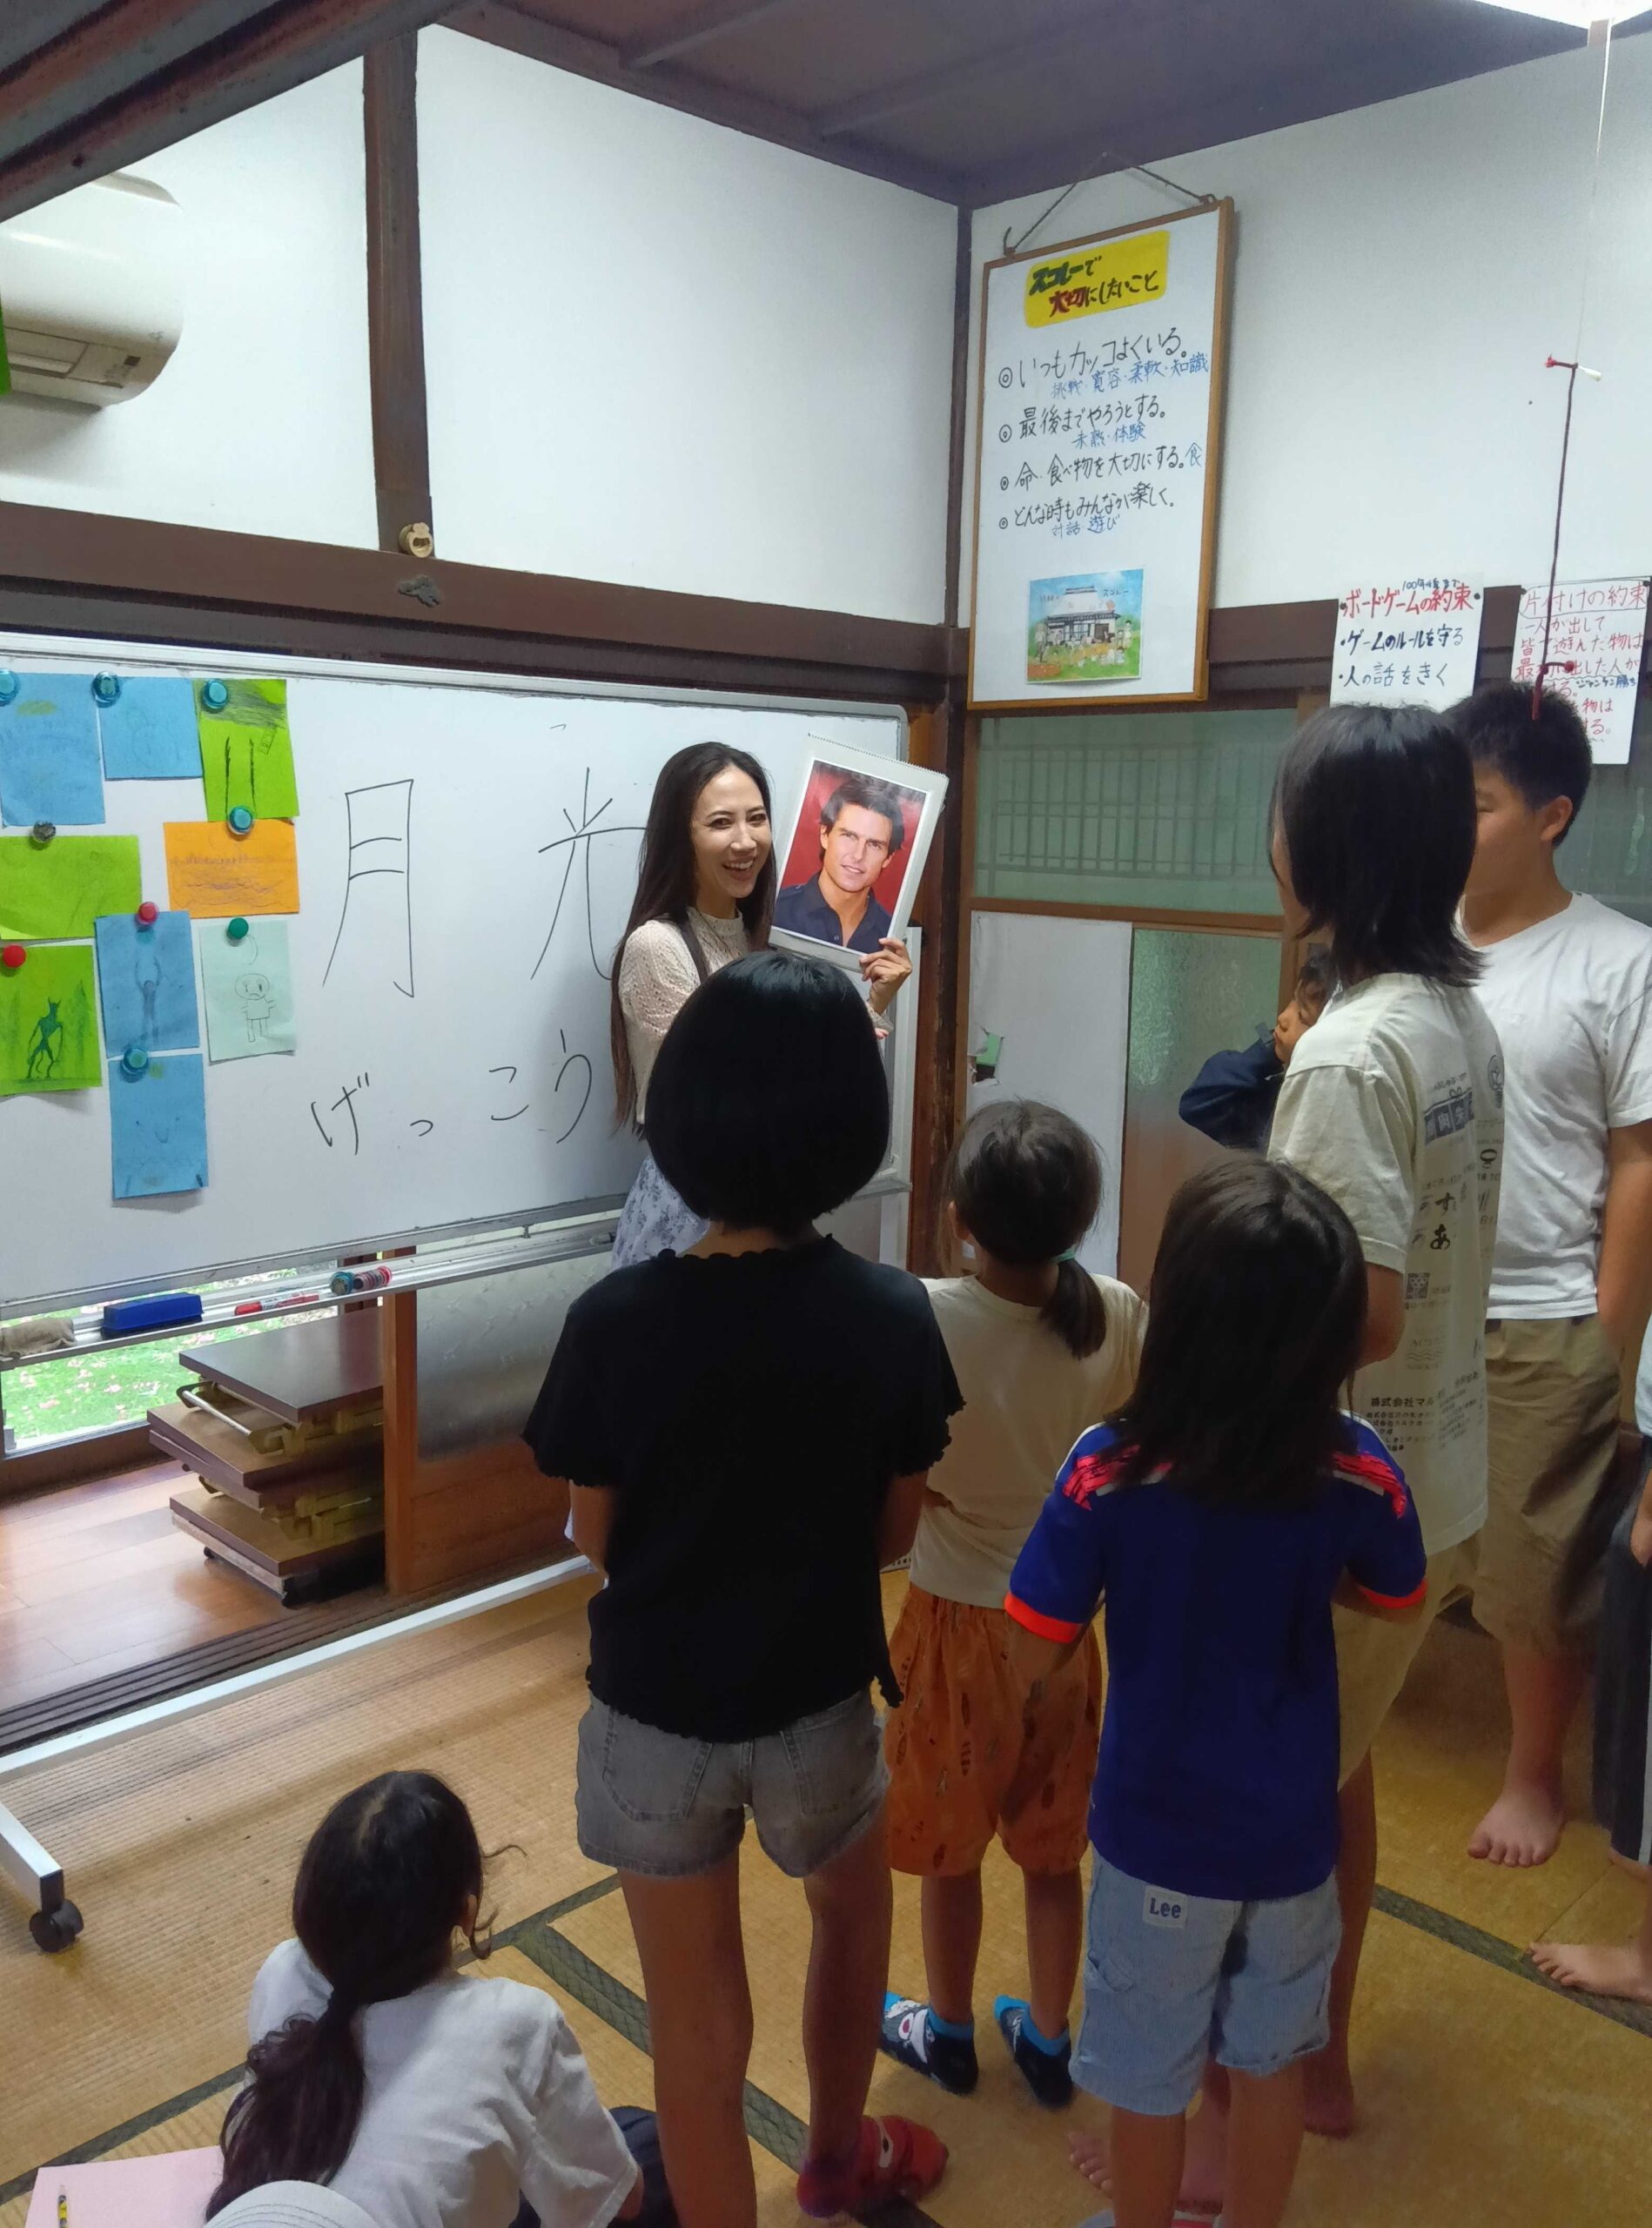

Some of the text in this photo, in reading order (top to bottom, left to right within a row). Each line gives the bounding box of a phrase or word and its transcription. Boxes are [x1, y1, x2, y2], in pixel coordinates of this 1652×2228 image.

[1048, 270, 1159, 319] 大切にしたいこと
[1343, 582, 1474, 619] ボードゲームの約束
[1522, 581, 1647, 616] 片付けの約束
[1150, 1897, 1182, 1919] Lee
